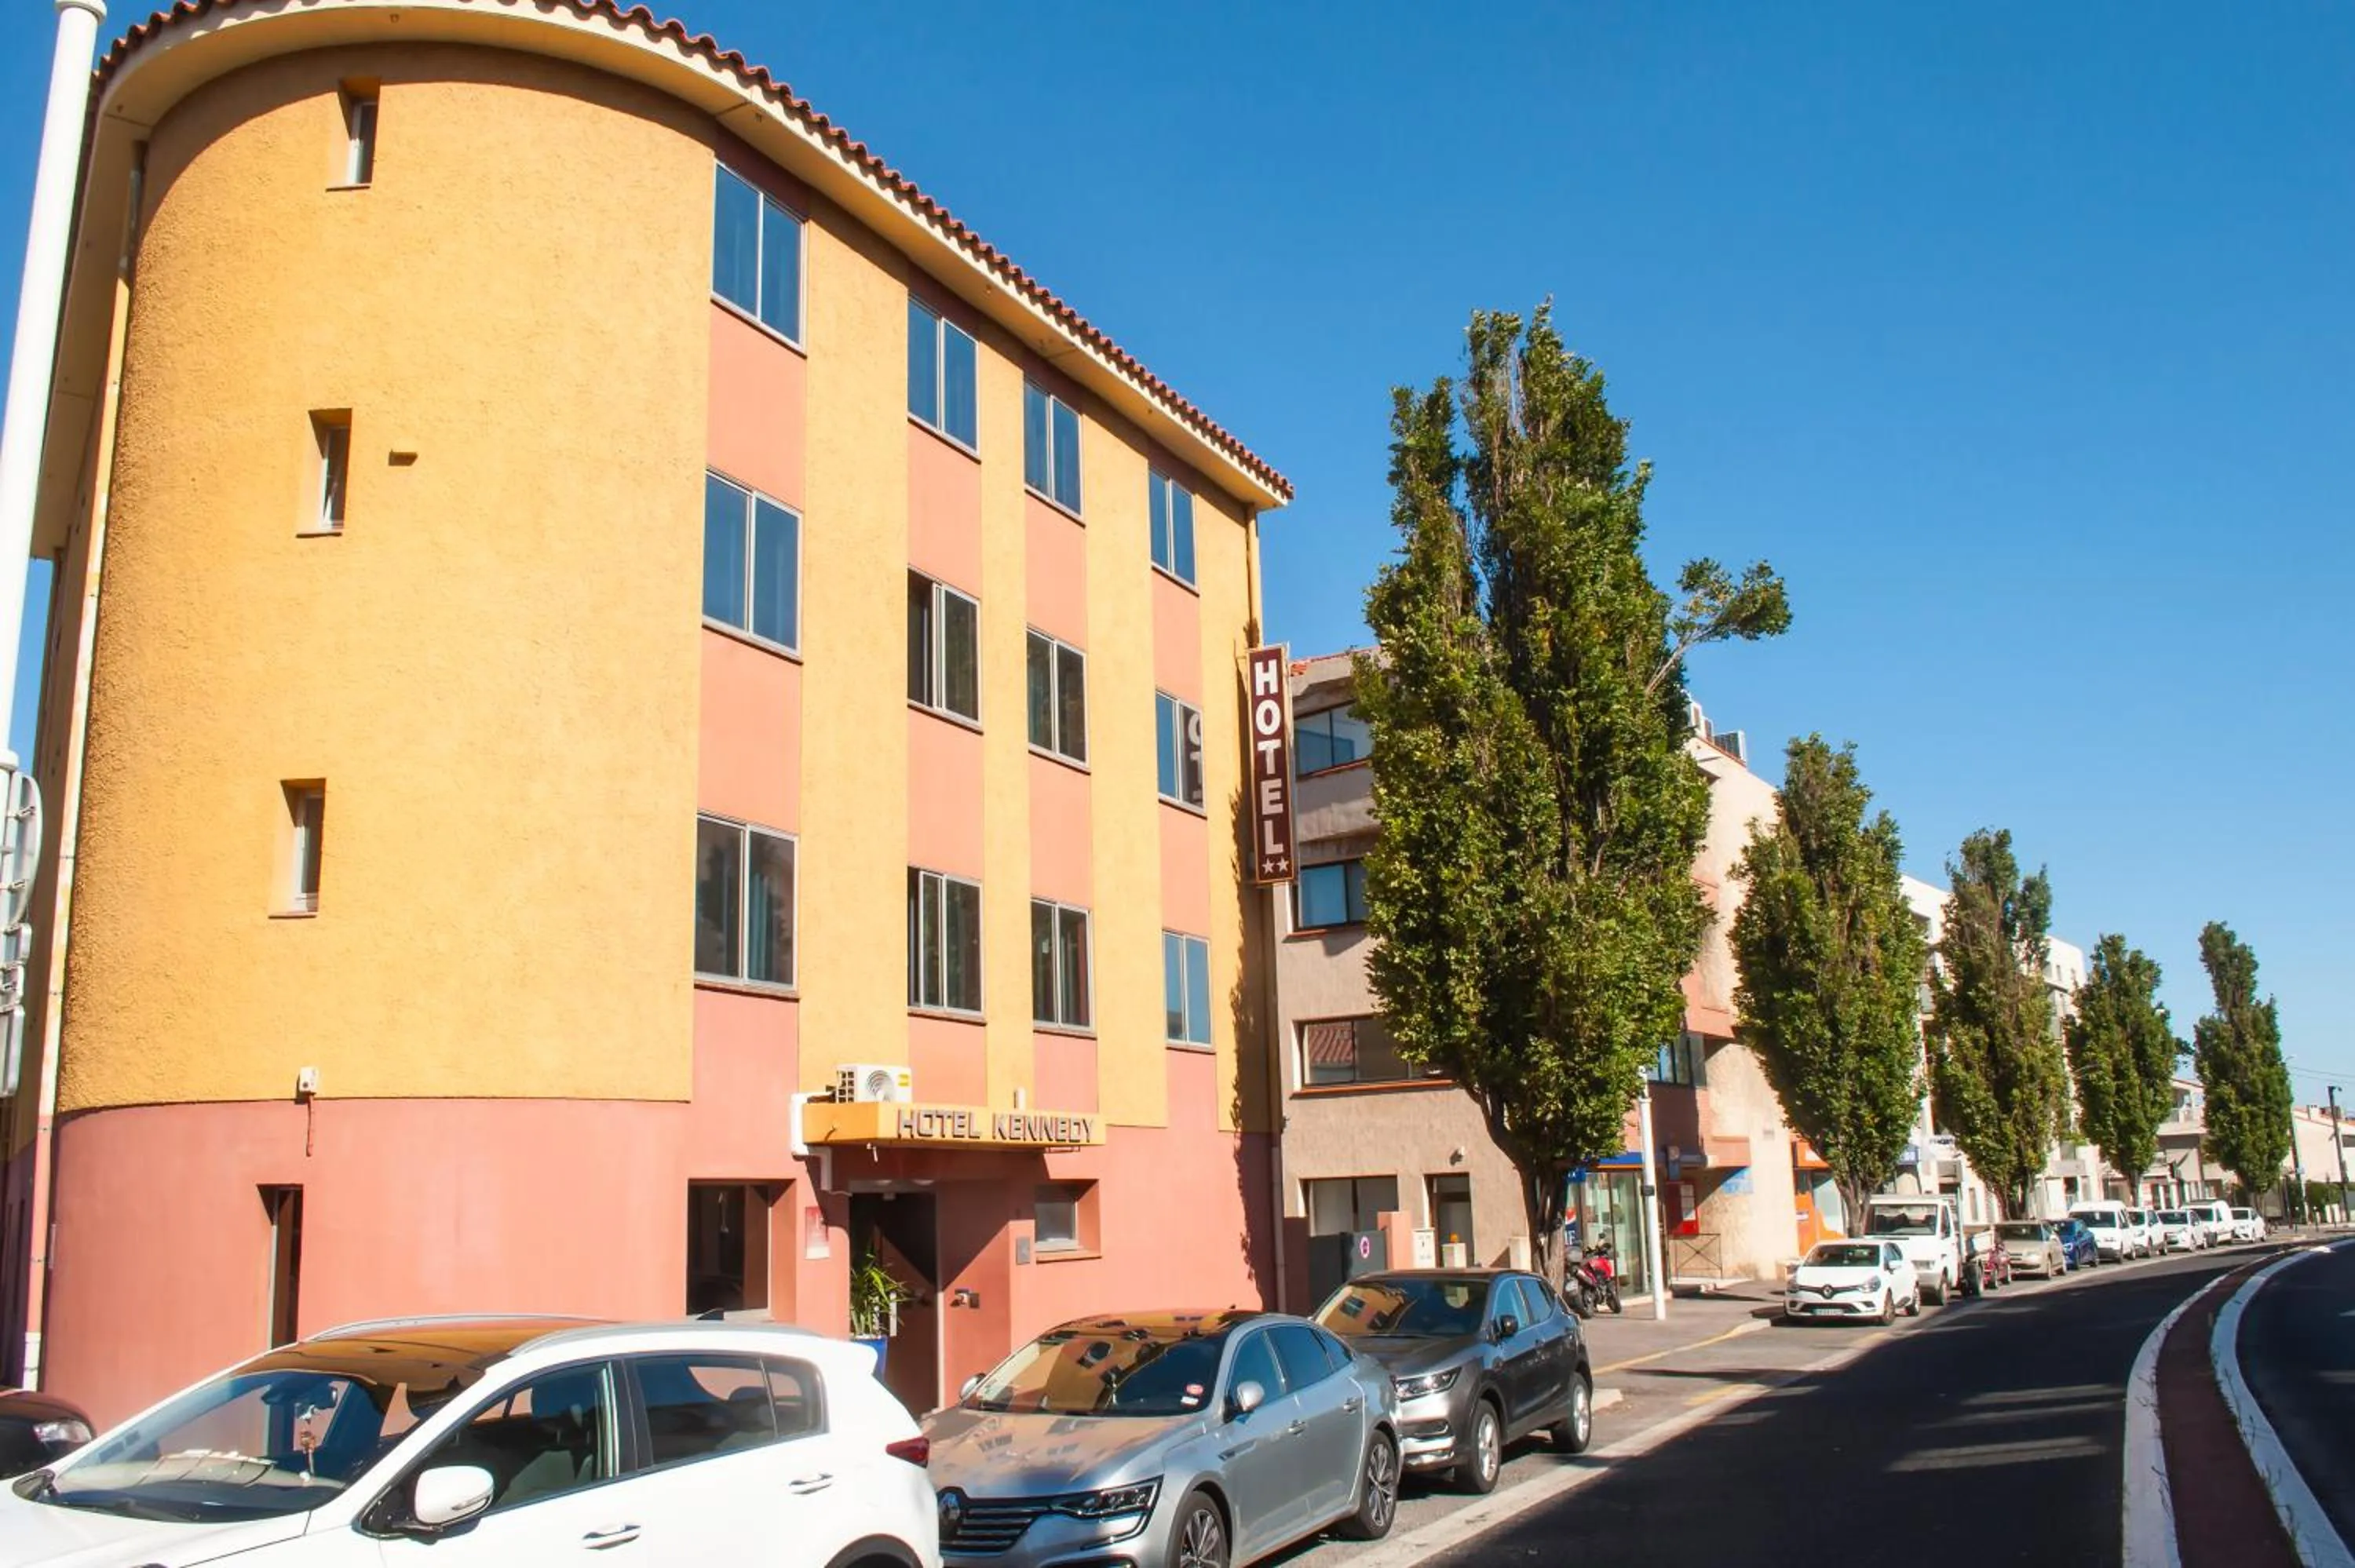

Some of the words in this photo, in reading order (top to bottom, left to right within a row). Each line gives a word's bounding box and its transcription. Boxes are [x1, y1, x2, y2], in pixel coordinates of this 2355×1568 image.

[1254, 658, 1284, 855] HOTEL
[897, 1108, 981, 1140] HOTEL
[991, 1111, 1094, 1143] KENNEDY
